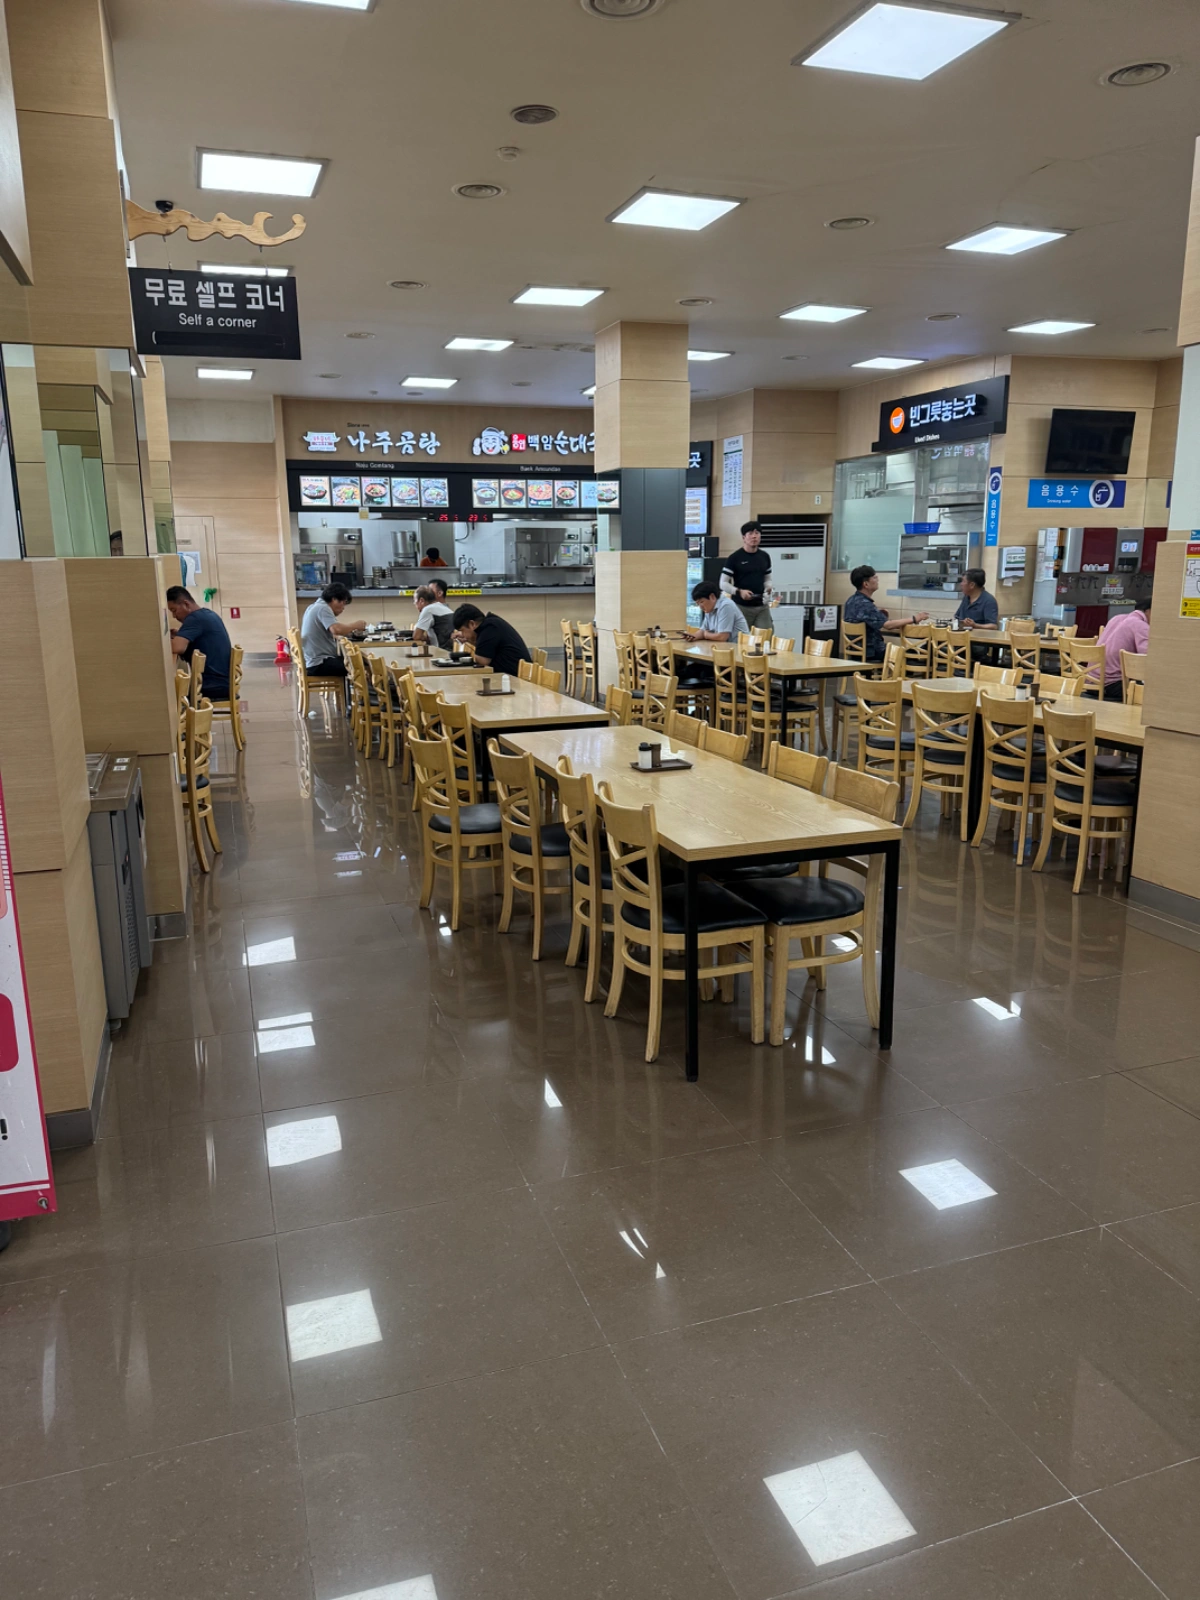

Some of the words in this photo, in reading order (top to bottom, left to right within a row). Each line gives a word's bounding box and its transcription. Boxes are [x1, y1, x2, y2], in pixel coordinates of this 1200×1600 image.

[145, 278, 187, 306] 무료
[196, 281, 237, 309] 셀프
[245, 284, 285, 312] 코너
[178, 313, 202, 326] Self
[206, 316, 214, 327] a
[217, 315, 257, 328] corner
[910, 393, 977, 427] 빈그릇놓는곳
[347, 430, 441, 455] 나주곰탕
